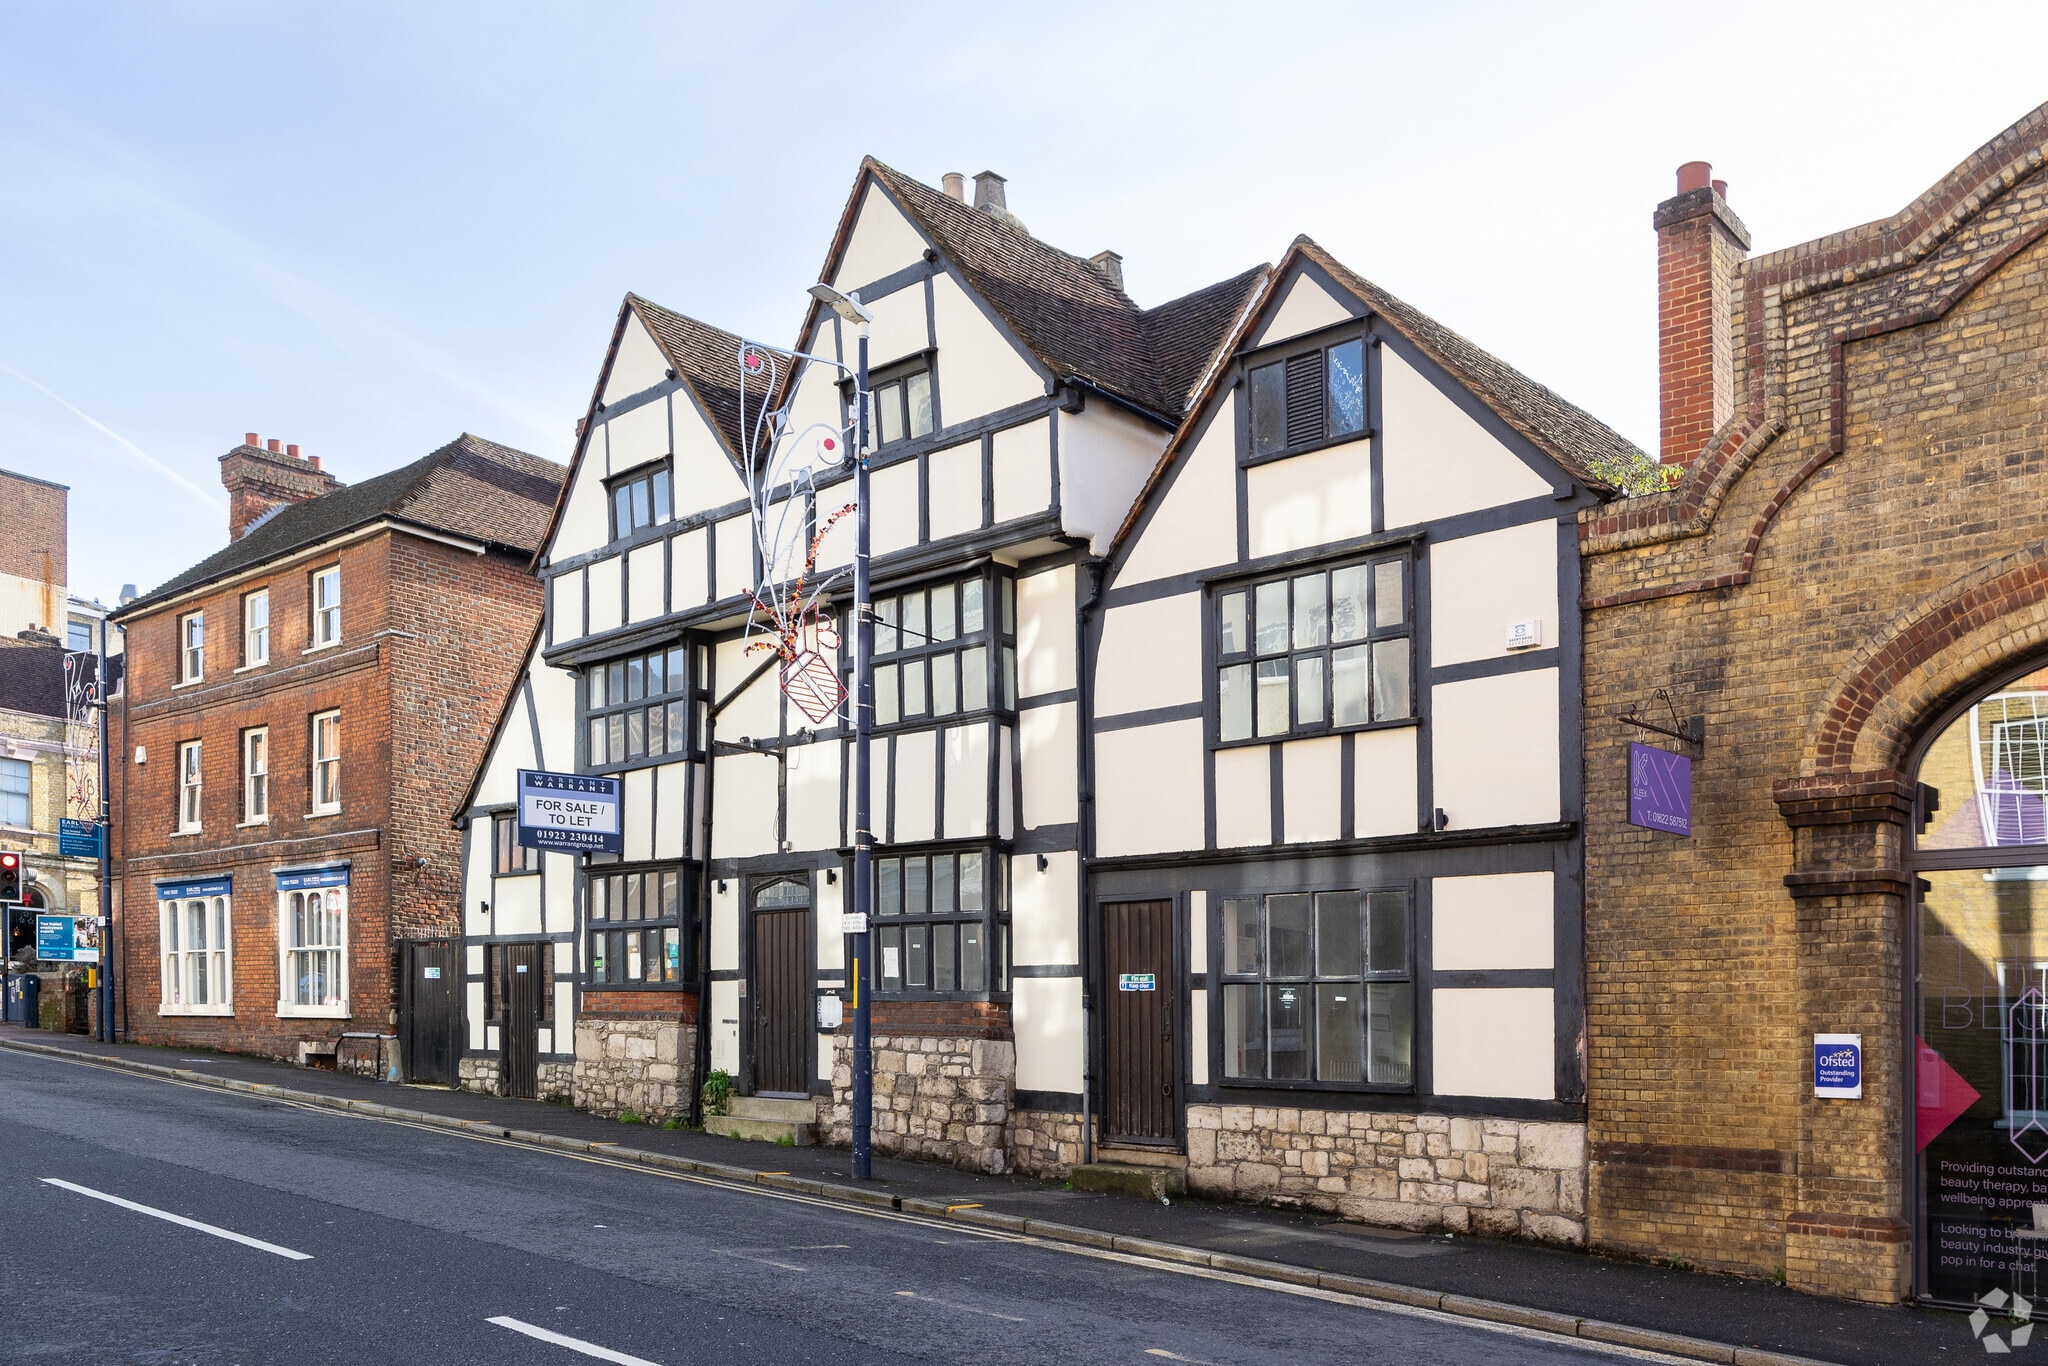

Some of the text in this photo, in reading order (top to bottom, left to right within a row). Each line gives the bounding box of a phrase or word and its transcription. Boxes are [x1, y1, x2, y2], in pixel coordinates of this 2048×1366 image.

[534, 775, 605, 786] WARRANT
[534, 781, 605, 792] WARRANT
[536, 800, 561, 811] FOR
[566, 802, 597, 814] SALE
[549, 814, 592, 826] TO LET
[1653, 812, 1668, 825] 01622
[537, 830, 604, 843] 01923 230414
[538, 839, 604, 849] www.warrantgroup.net
[1820, 1055, 1855, 1067] Ofsted
[1941, 1160, 1994, 1176] Providing
[1941, 1176, 2047, 1194] beauty therapy, ba
[1941, 1192, 1995, 1207] wellbeing
[1941, 1222, 1986, 1238] Looking
[1990, 1227, 2001, 1237] to
[1941, 1237, 1979, 1253] beauty
[1983, 1241, 2030, 1258] industry
[1941, 1255, 2037, 1273] pop in for a chat.
